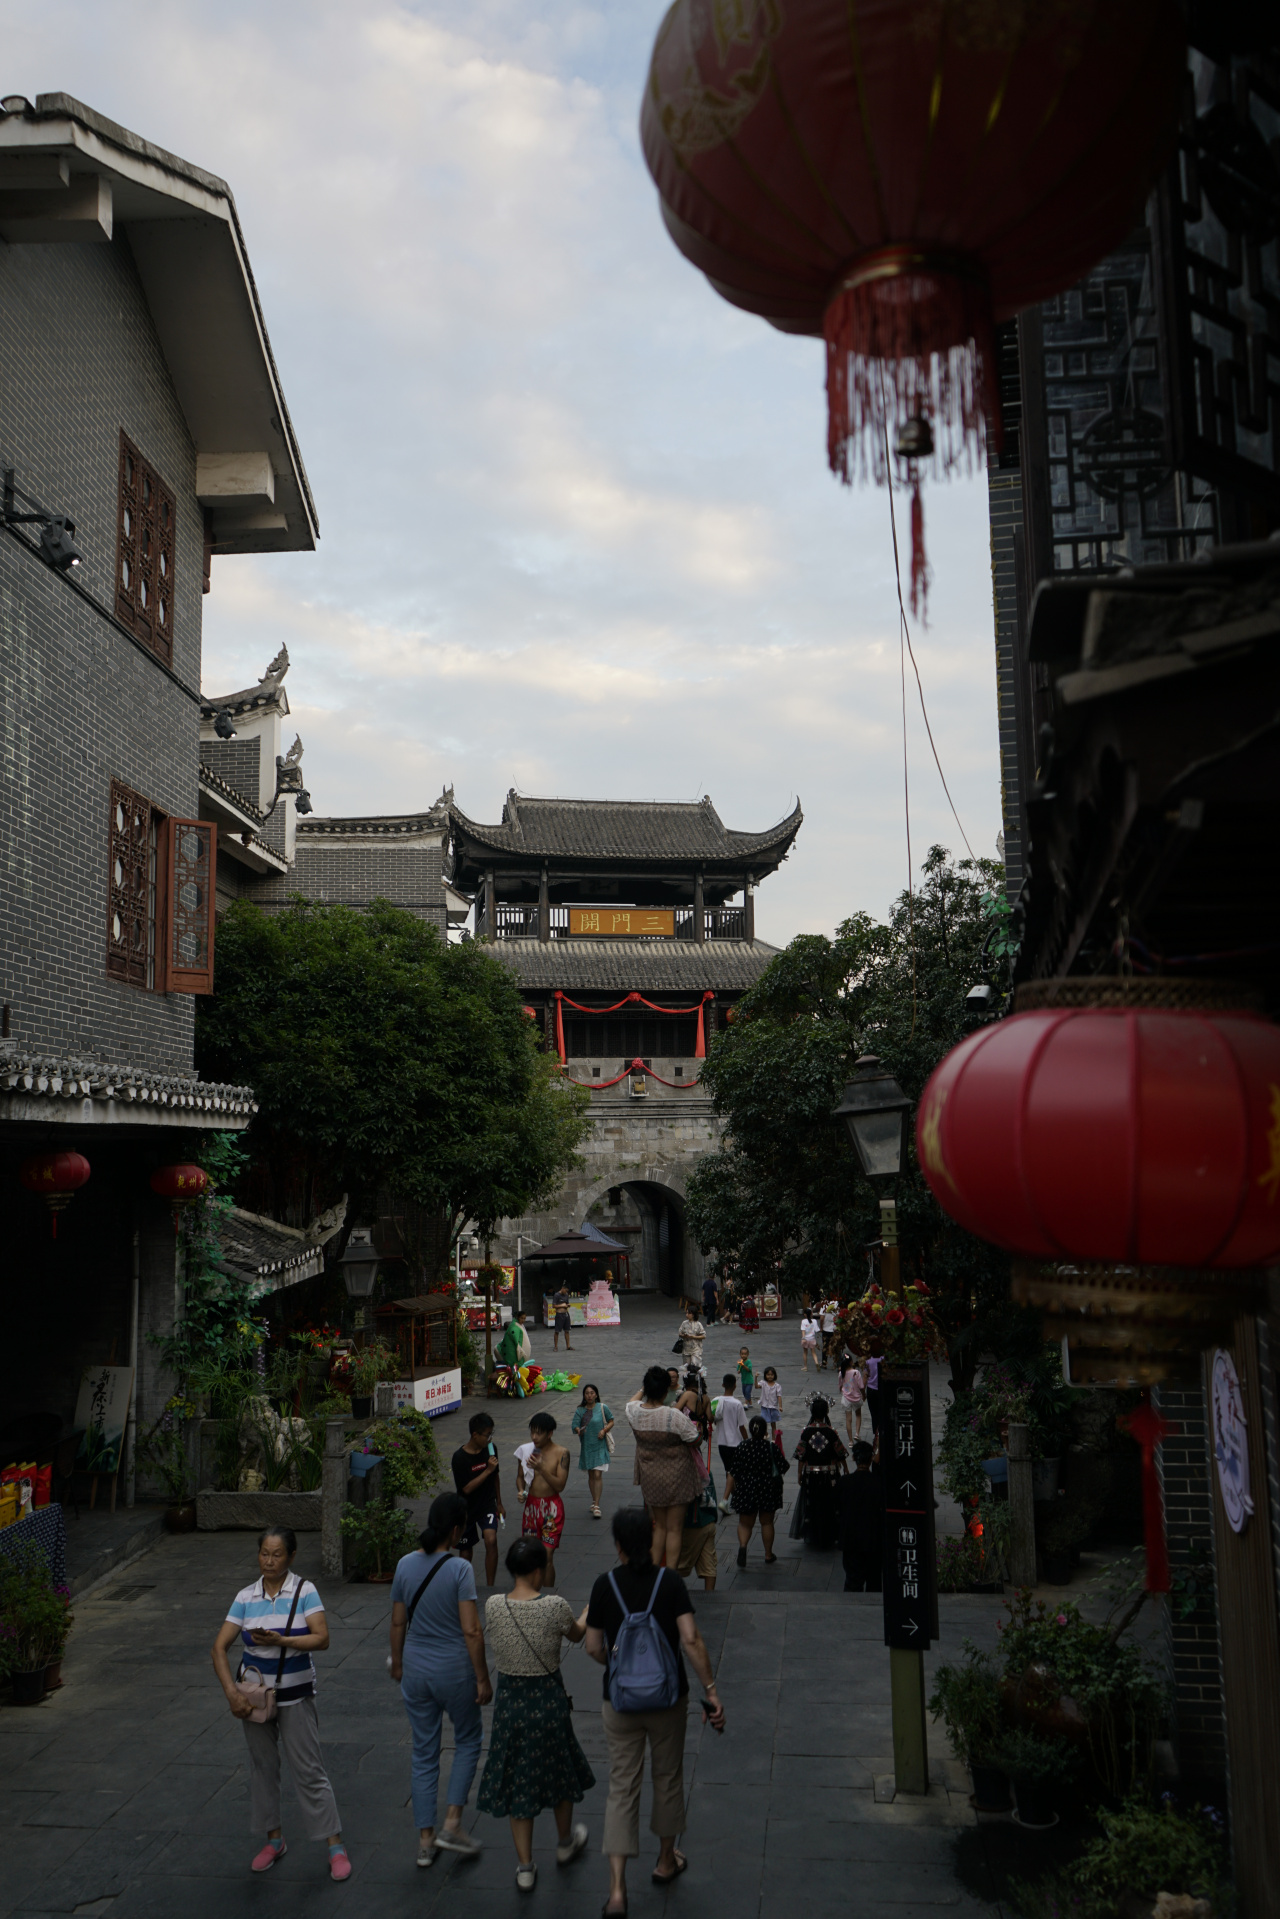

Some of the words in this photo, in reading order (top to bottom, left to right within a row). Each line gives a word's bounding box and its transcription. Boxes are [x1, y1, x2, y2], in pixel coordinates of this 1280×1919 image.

[898, 1408, 915, 1456] 三门开
[486, 1513, 494, 1524] 7
[902, 1549, 919, 1599] 卫生间
